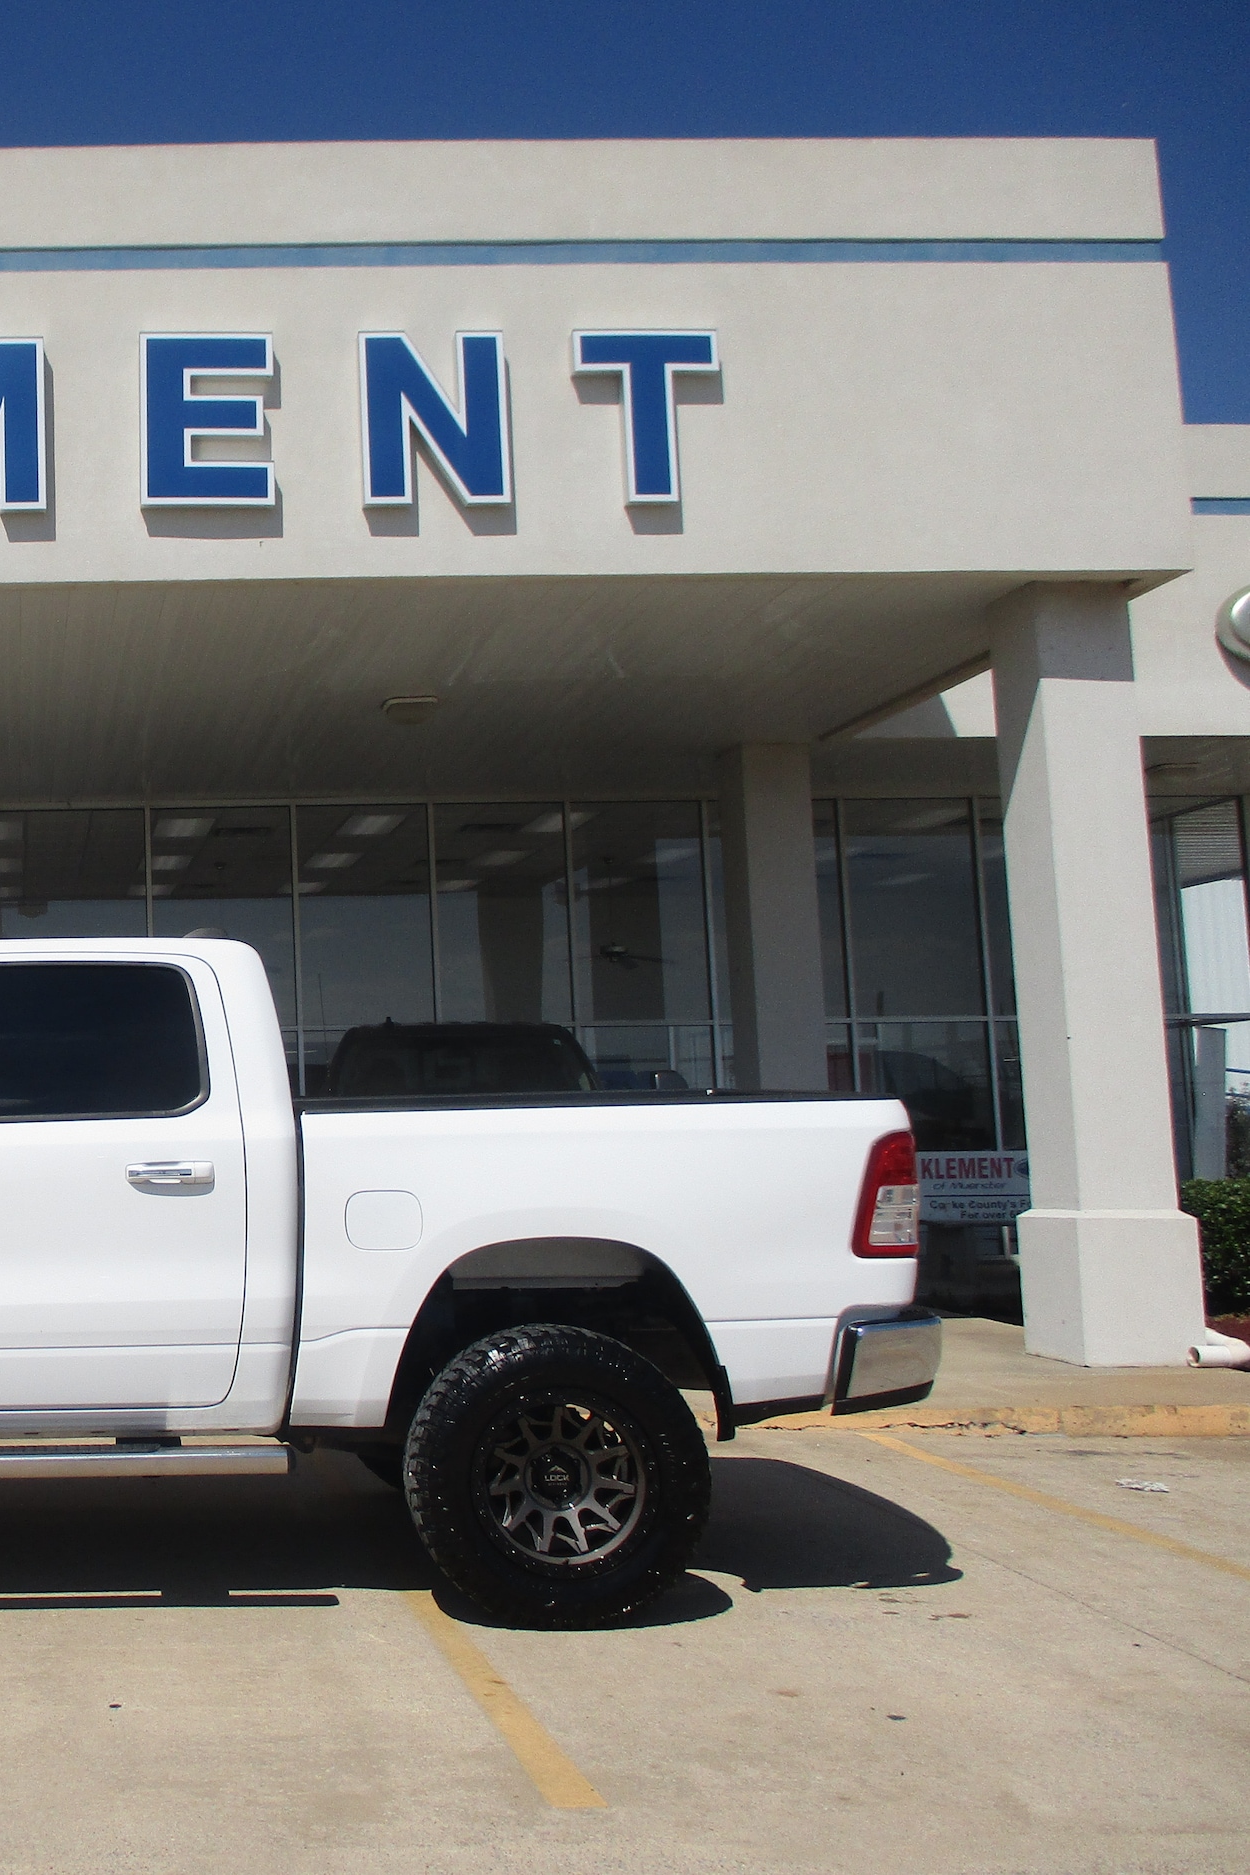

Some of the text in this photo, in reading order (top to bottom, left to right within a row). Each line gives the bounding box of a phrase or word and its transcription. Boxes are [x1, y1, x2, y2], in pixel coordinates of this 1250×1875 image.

[921, 1158, 1014, 1179] KLEMENT
[933, 1182, 945, 1191] of
[968, 1200, 1017, 1210] County's
[960, 1211, 979, 1219] For
[982, 1211, 1006, 1219] over
